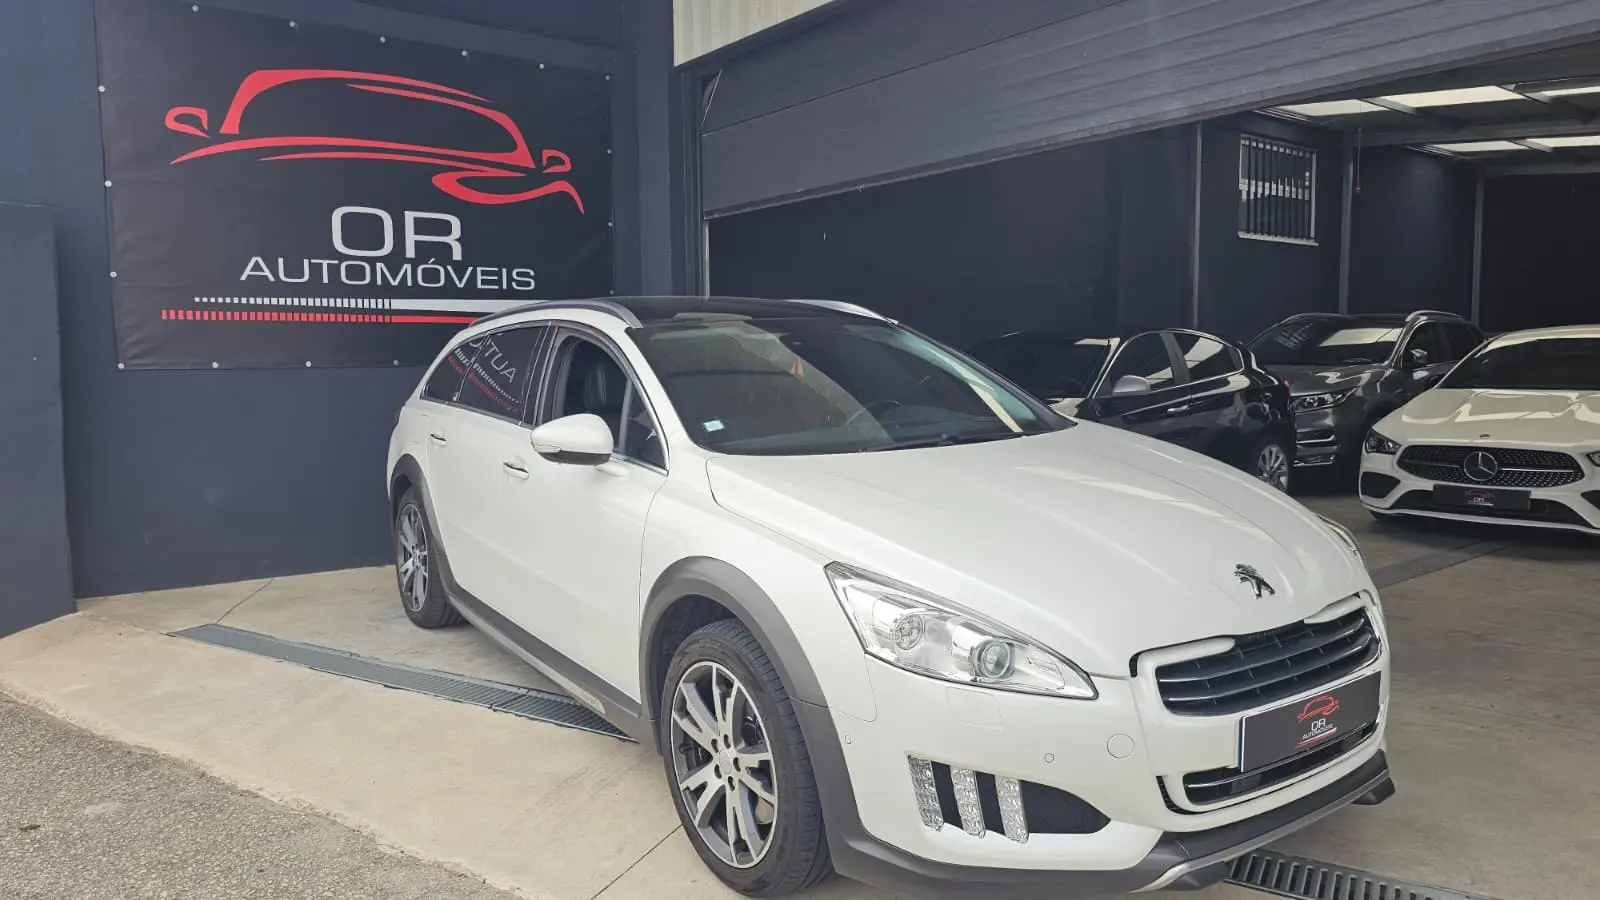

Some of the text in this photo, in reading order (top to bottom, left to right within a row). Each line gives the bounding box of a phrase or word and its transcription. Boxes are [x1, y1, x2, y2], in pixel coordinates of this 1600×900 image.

[331, 206, 462, 261] OR
[240, 257, 535, 290] AUTOMÓVEIS
[1311, 718, 1326, 731] OR
